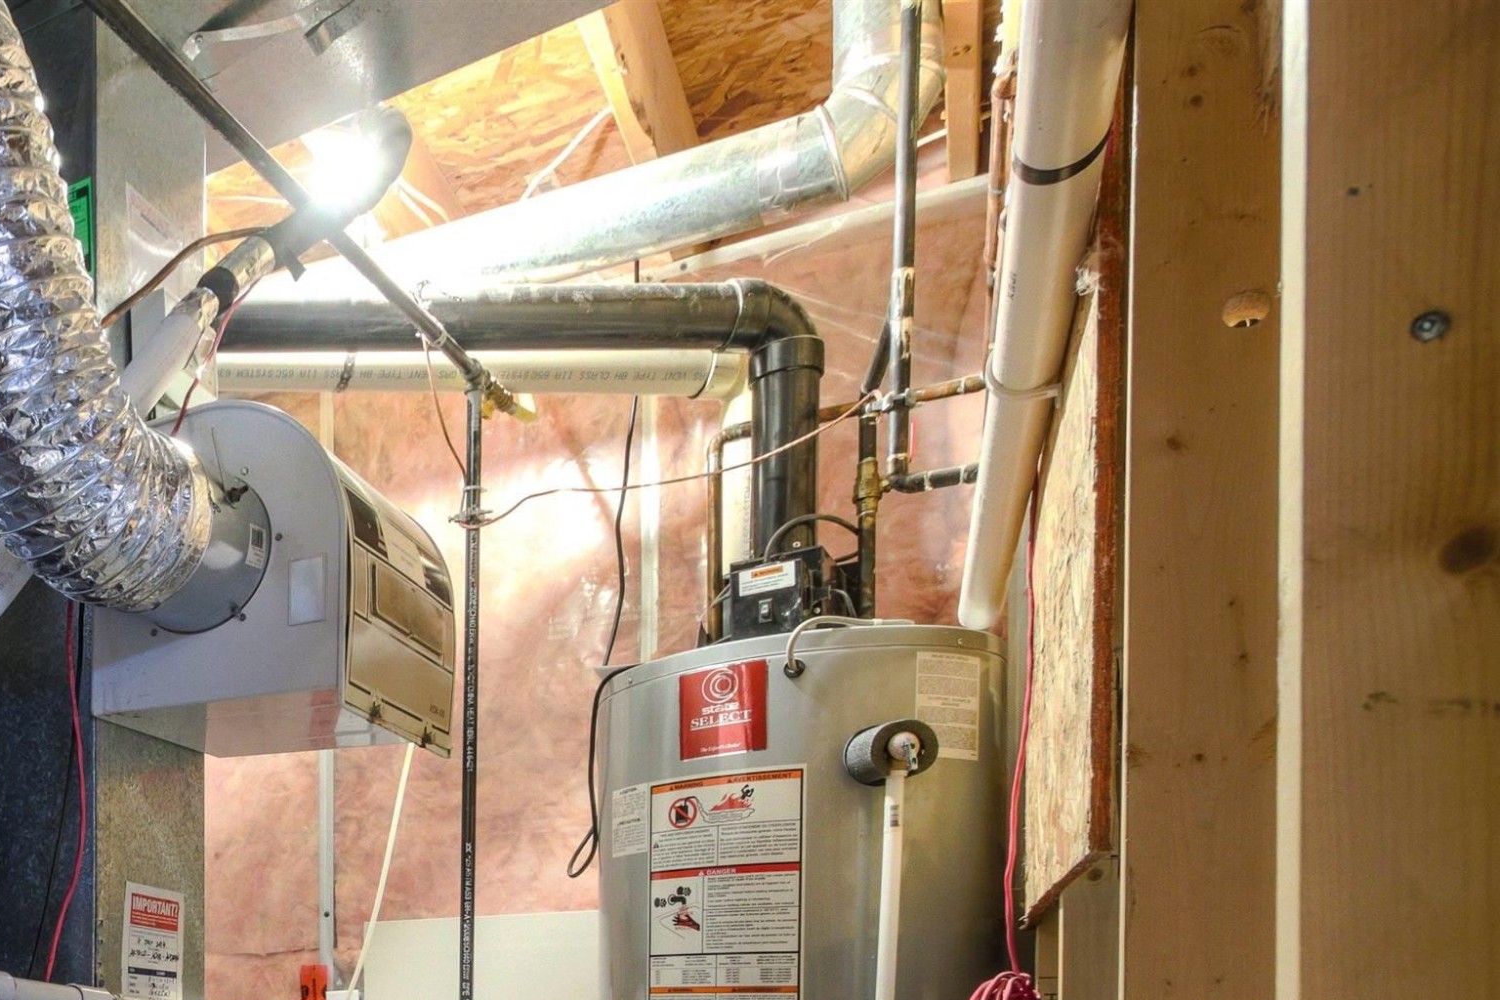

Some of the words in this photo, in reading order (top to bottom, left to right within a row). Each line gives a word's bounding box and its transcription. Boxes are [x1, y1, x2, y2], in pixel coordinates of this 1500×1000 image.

[690, 709, 752, 729] SELECT
[732, 772, 793, 783] AVERTISSEMENT
[706, 867, 737, 876] DANGER
[132, 895, 179, 918] IMPORTANT!
